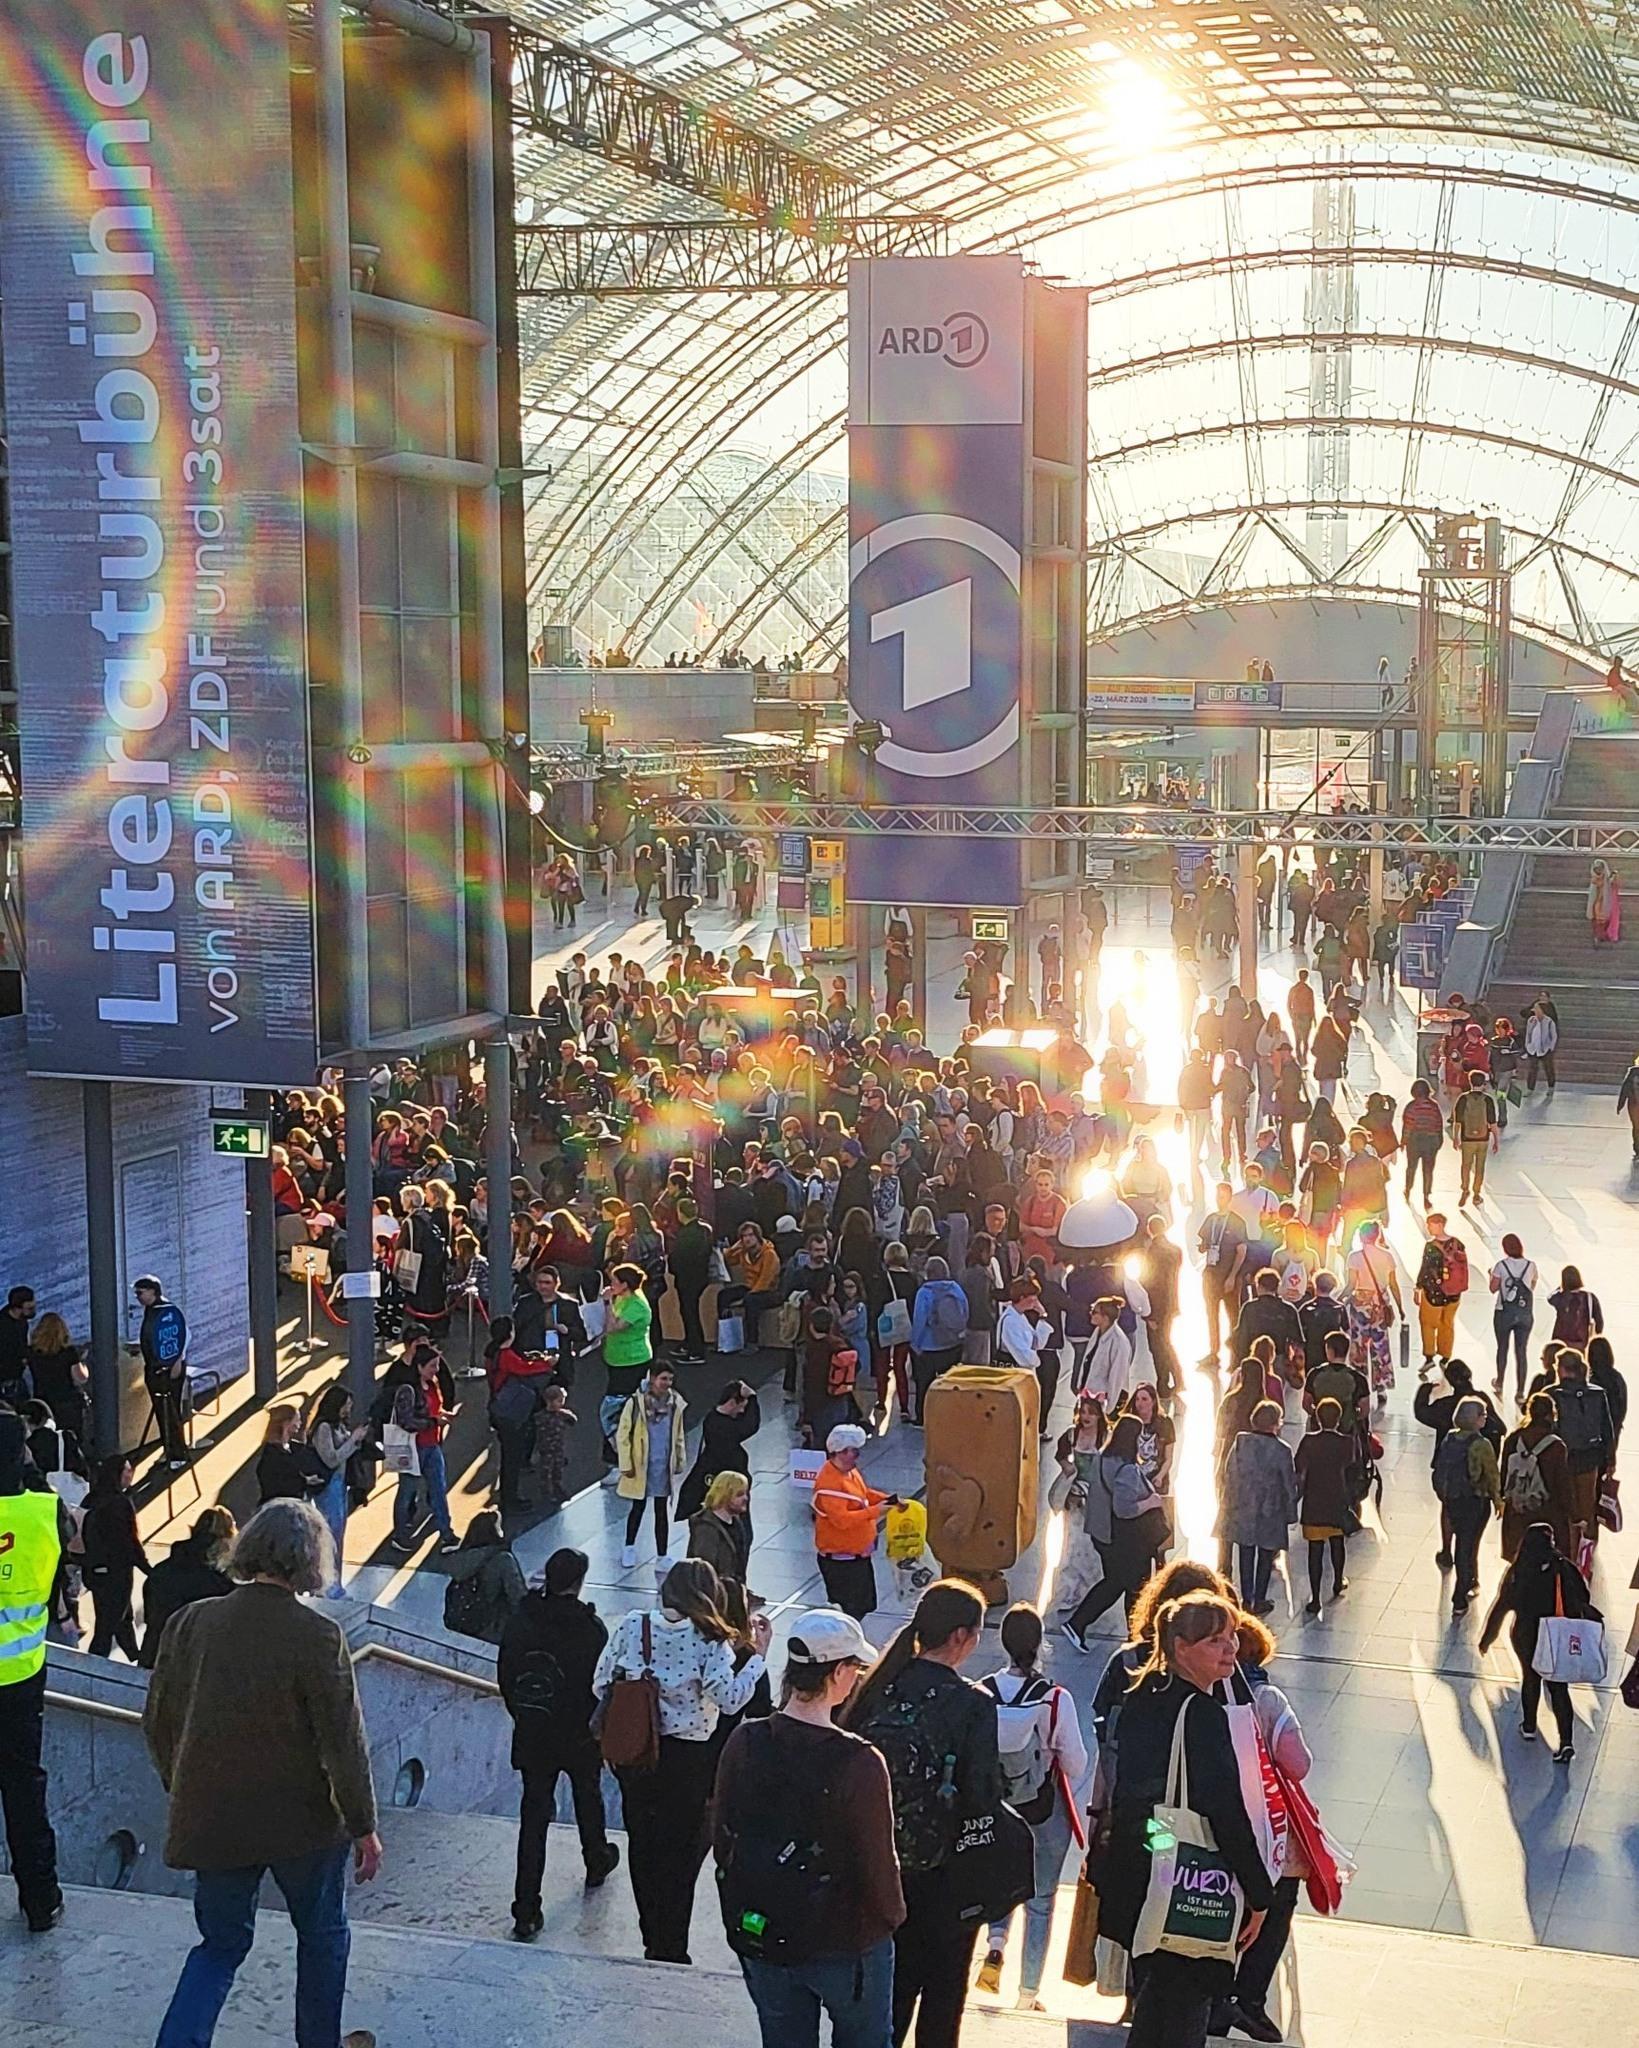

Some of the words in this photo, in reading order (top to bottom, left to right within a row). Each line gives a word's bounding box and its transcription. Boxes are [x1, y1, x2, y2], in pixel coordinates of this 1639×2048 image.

[878, 327, 944, 354] ARD
[183, 345, 224, 485] 3sat
[67, 32, 178, 1024] Literaturbühne
[184, 503, 226, 615] und
[188, 633, 230, 753] ZDF
[194, 770, 240, 910] ARD,
[207, 928, 239, 1034] von
[955, 1830, 996, 1852] GREAT!
[1176, 1902, 1230, 1918] KONJUNKTIV
[1187, 1895, 1202, 1905] IST
[1202, 1897, 1223, 1909] KEIN
